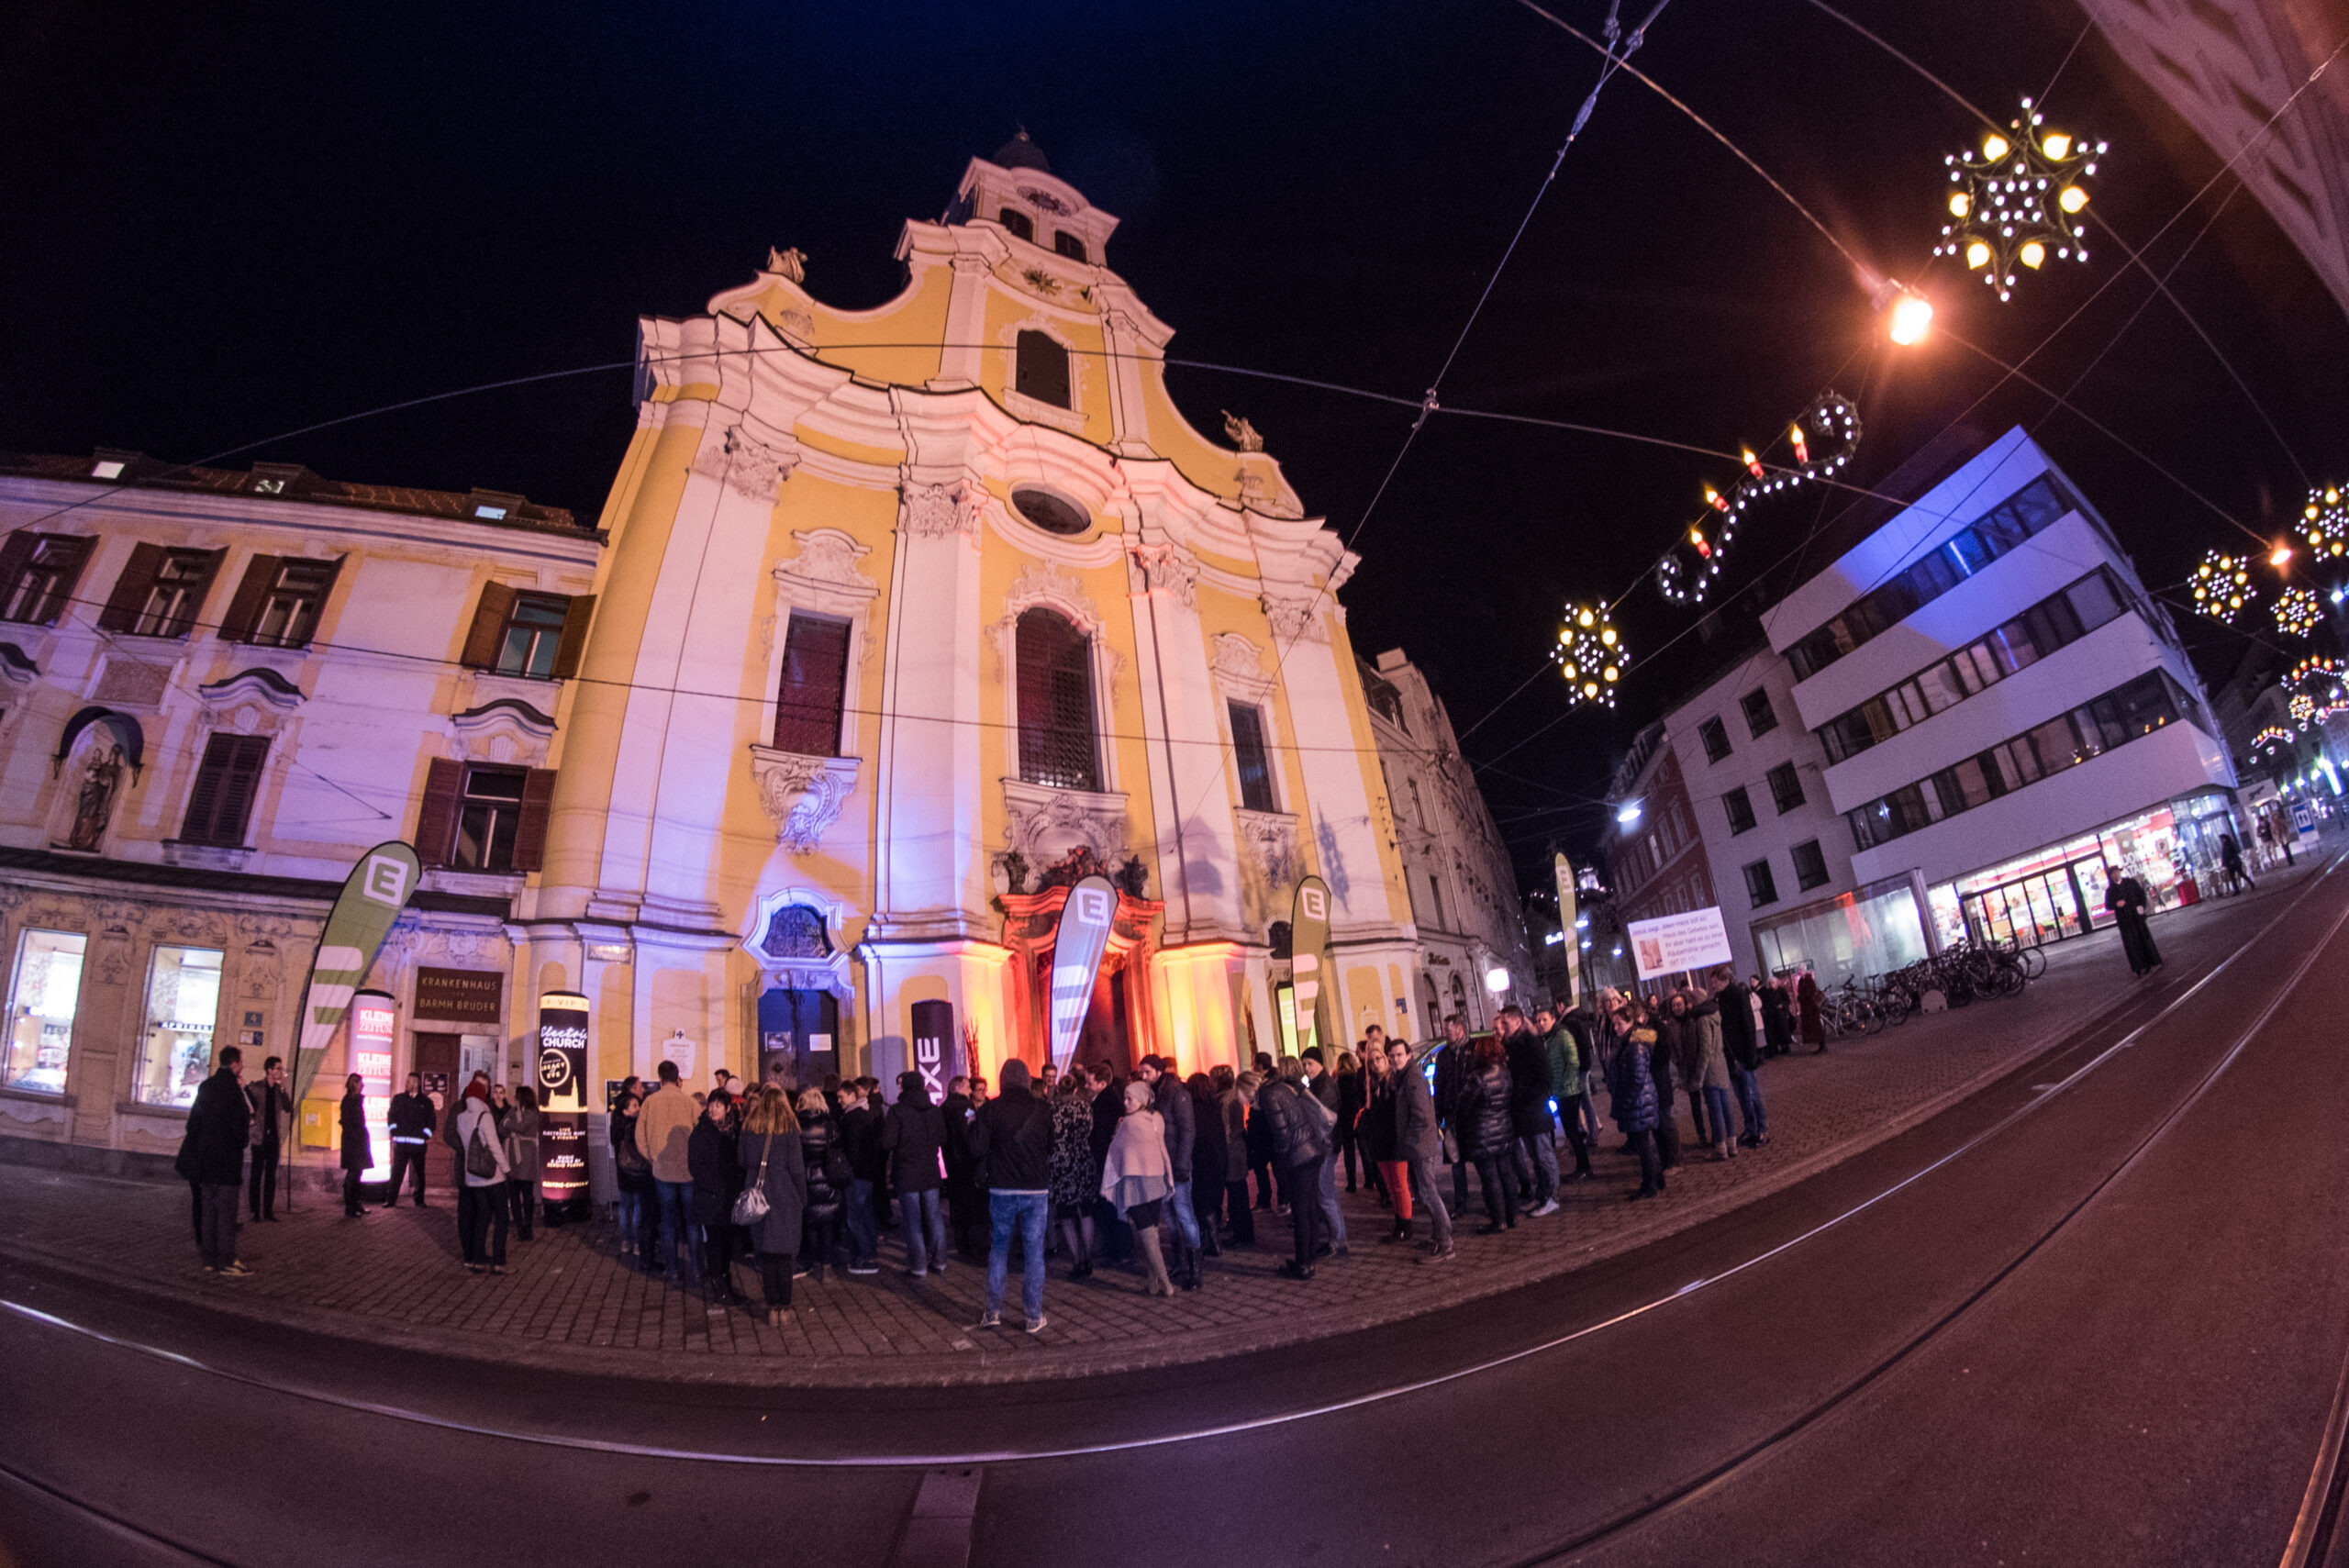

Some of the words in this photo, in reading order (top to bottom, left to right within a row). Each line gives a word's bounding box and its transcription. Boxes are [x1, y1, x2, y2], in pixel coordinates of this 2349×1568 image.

[421, 977, 497, 991] KRANKENHAUS
[359, 1022, 393, 1035] ZEITUN
[542, 1037, 584, 1049] CHURCH
[357, 1064, 391, 1077] ZEITUN
